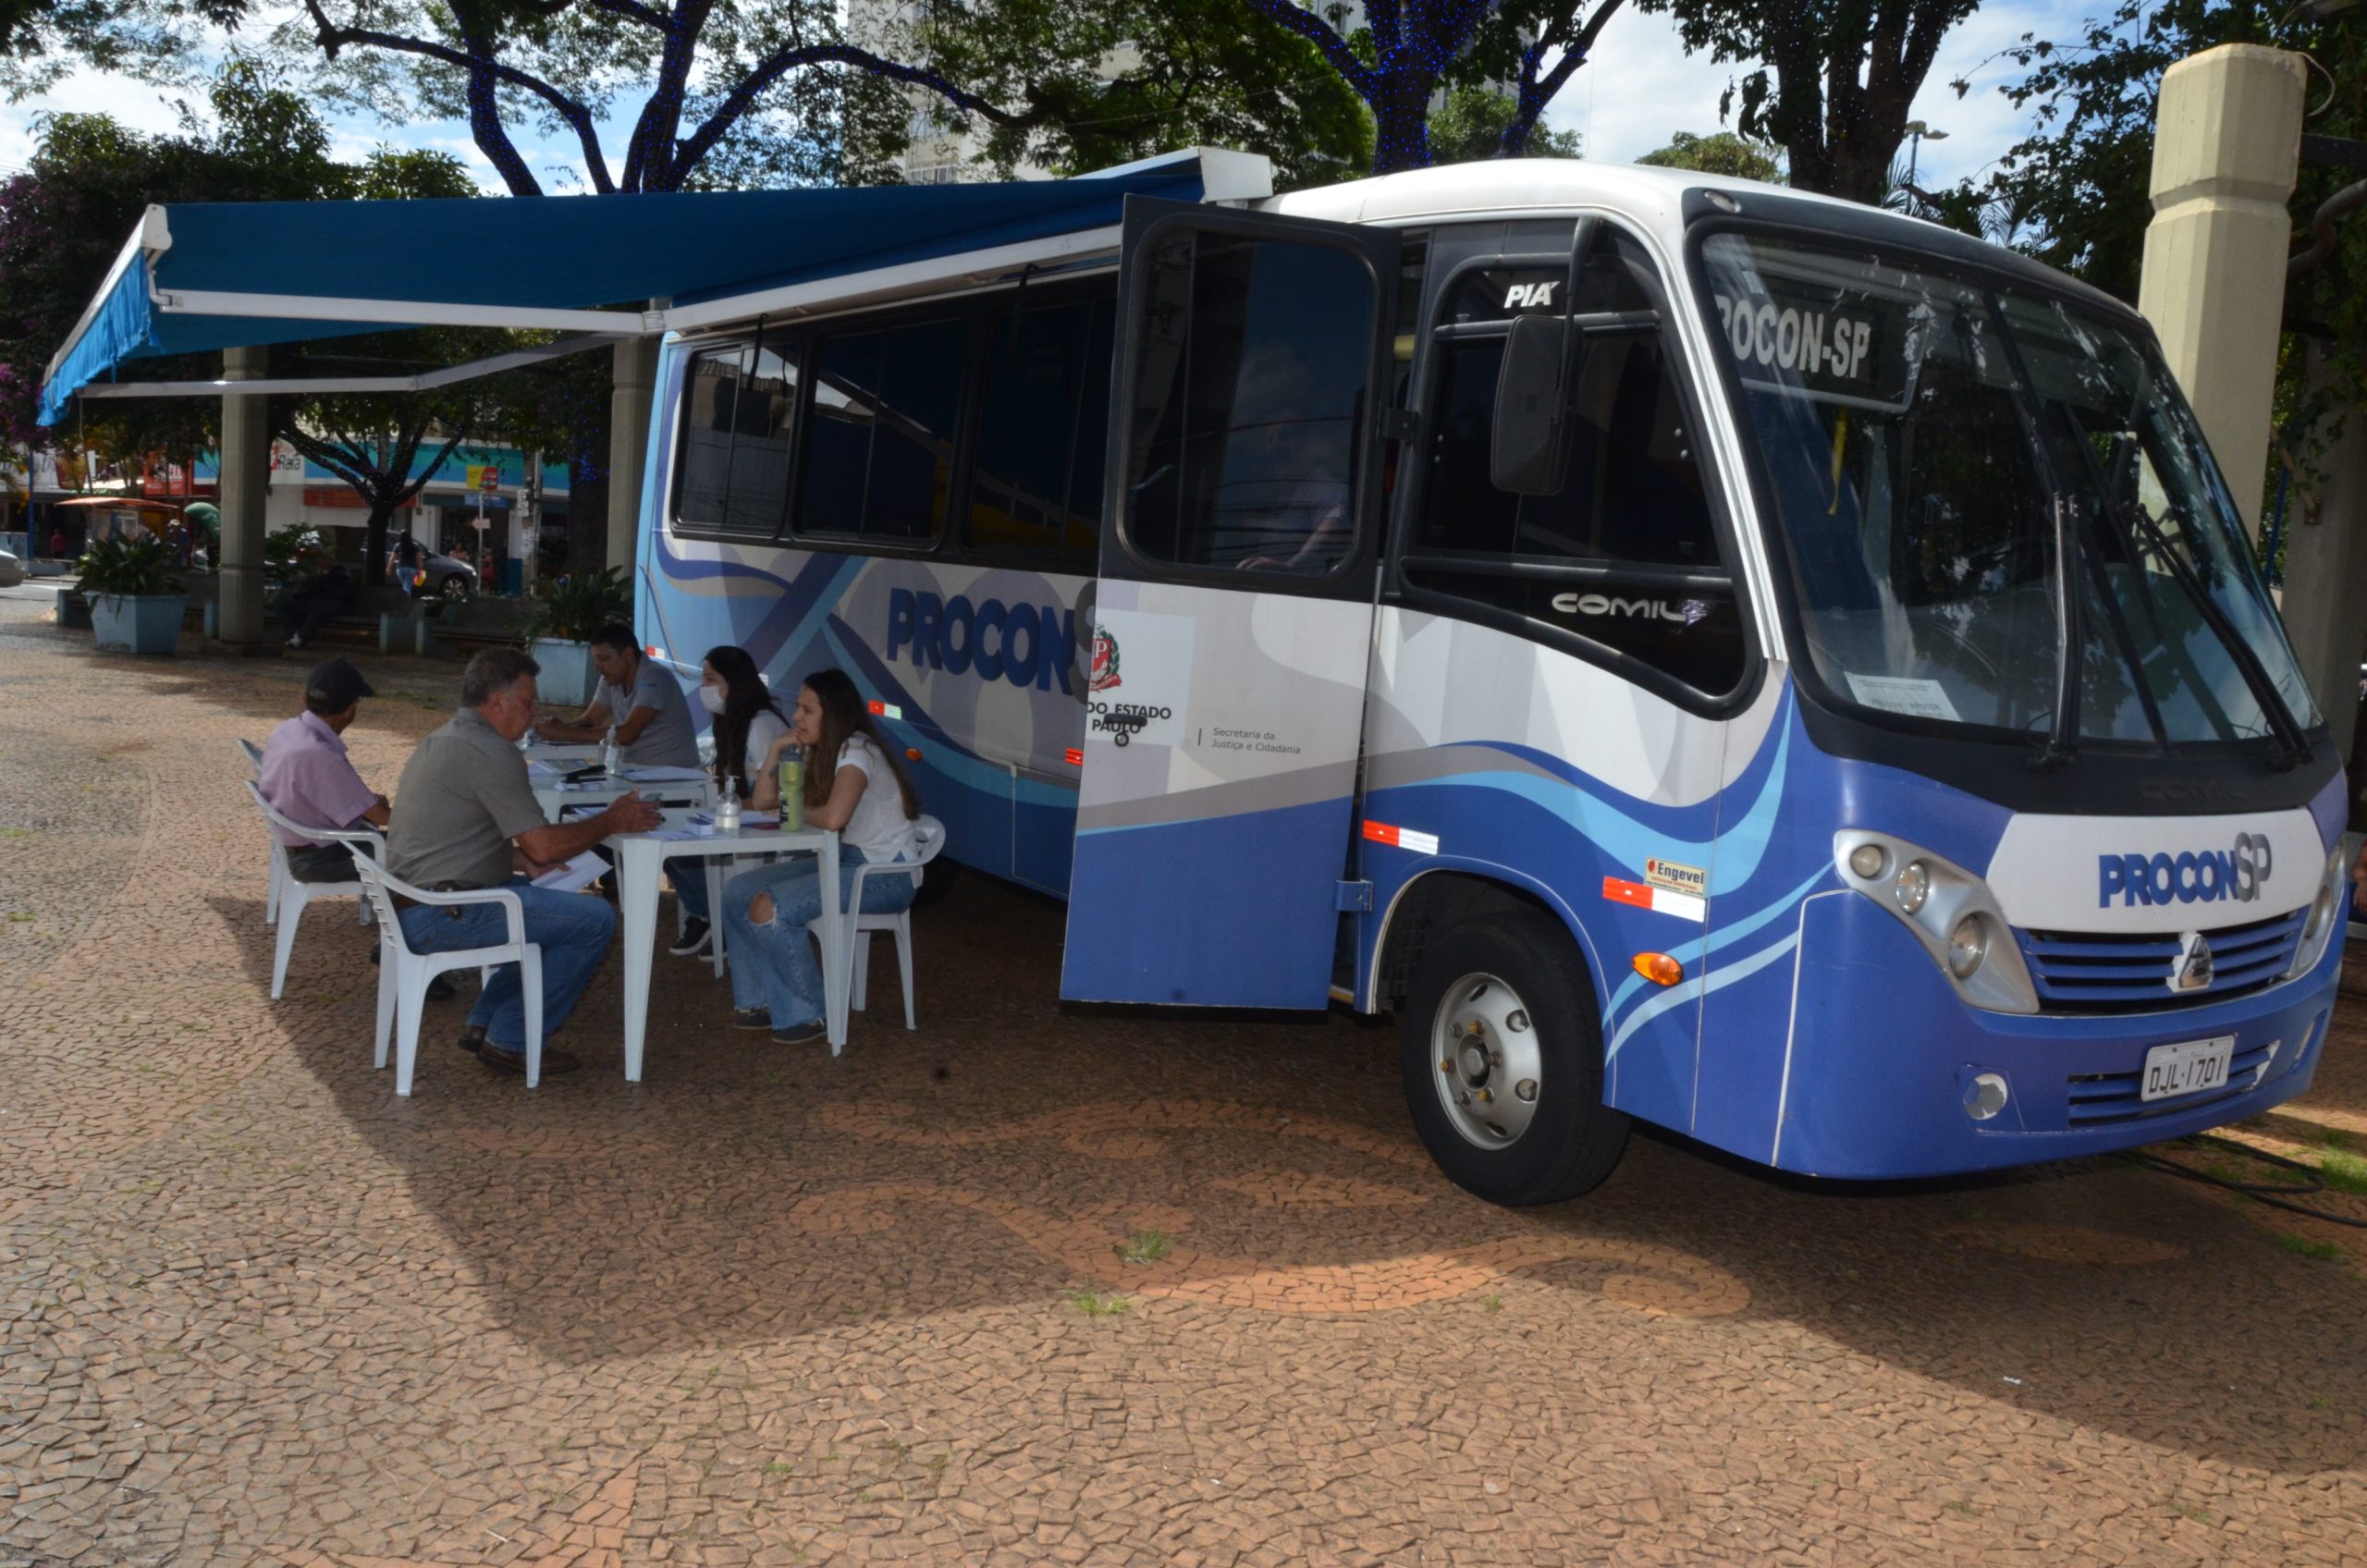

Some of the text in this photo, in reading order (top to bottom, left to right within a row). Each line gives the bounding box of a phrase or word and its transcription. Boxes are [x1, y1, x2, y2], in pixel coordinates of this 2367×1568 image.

[1551, 593, 1686, 622] COMIL
[1114, 704, 1171, 720] ESTADO
[1092, 718, 1141, 734] PAULO
[1213, 727, 1275, 741] Secretaria da
[1211, 740, 1301, 754] Justiça e Cidadania
[1657, 863, 1704, 885] Engevel
